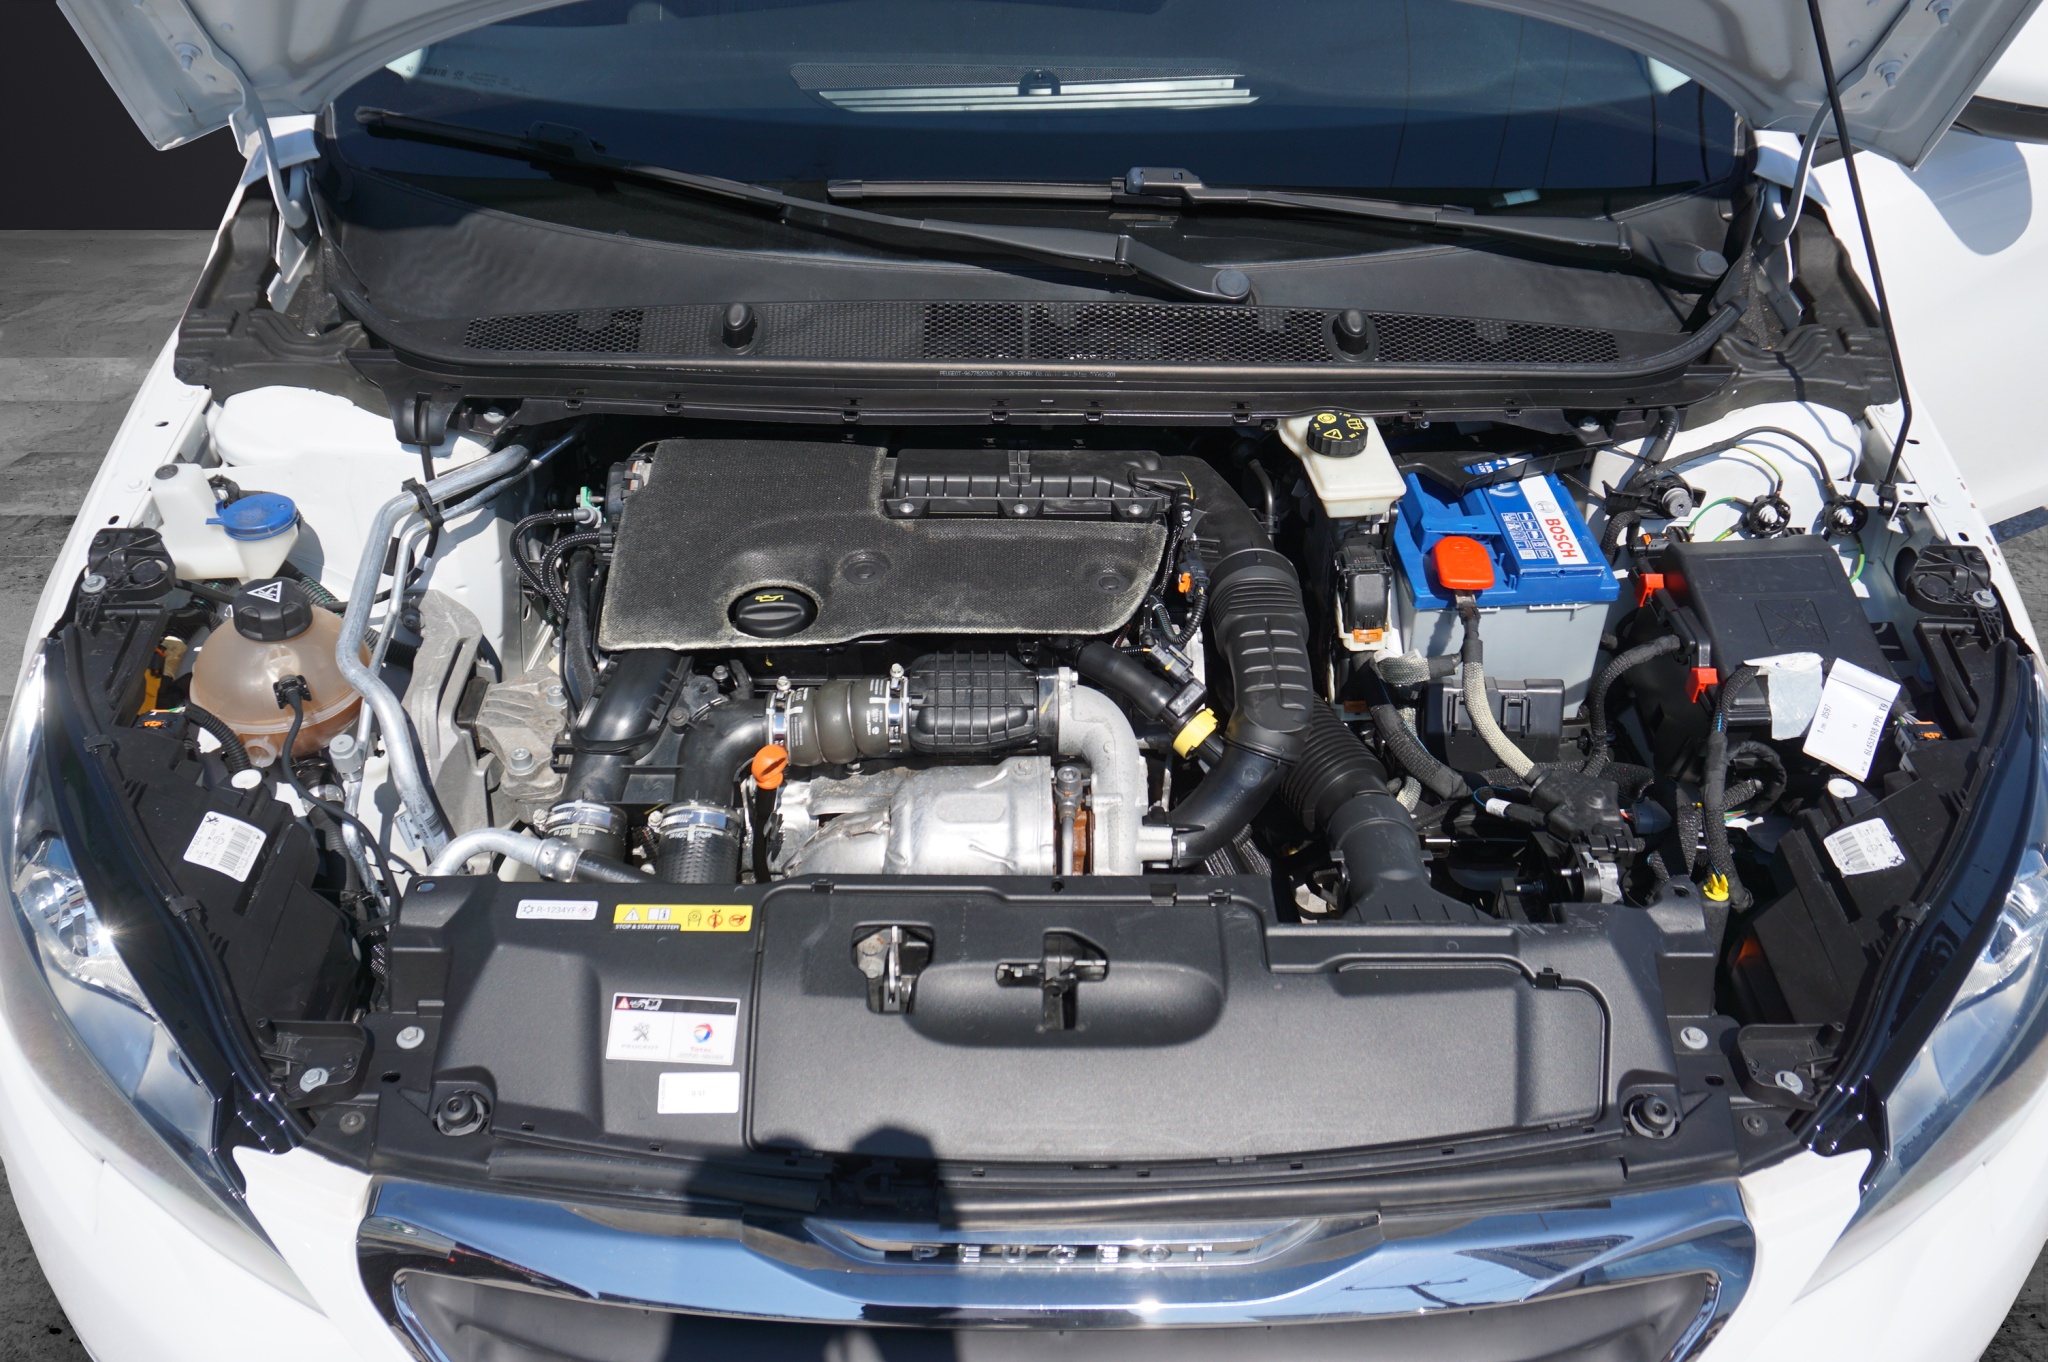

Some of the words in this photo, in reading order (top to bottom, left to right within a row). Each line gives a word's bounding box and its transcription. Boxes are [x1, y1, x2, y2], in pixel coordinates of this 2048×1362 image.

[1545, 518, 1578, 559] BOSCH
[1878, 703, 1889, 712] T9
[1873, 715, 1884, 728] PPL
[911, 1243, 1214, 1265] PEUGEOT
